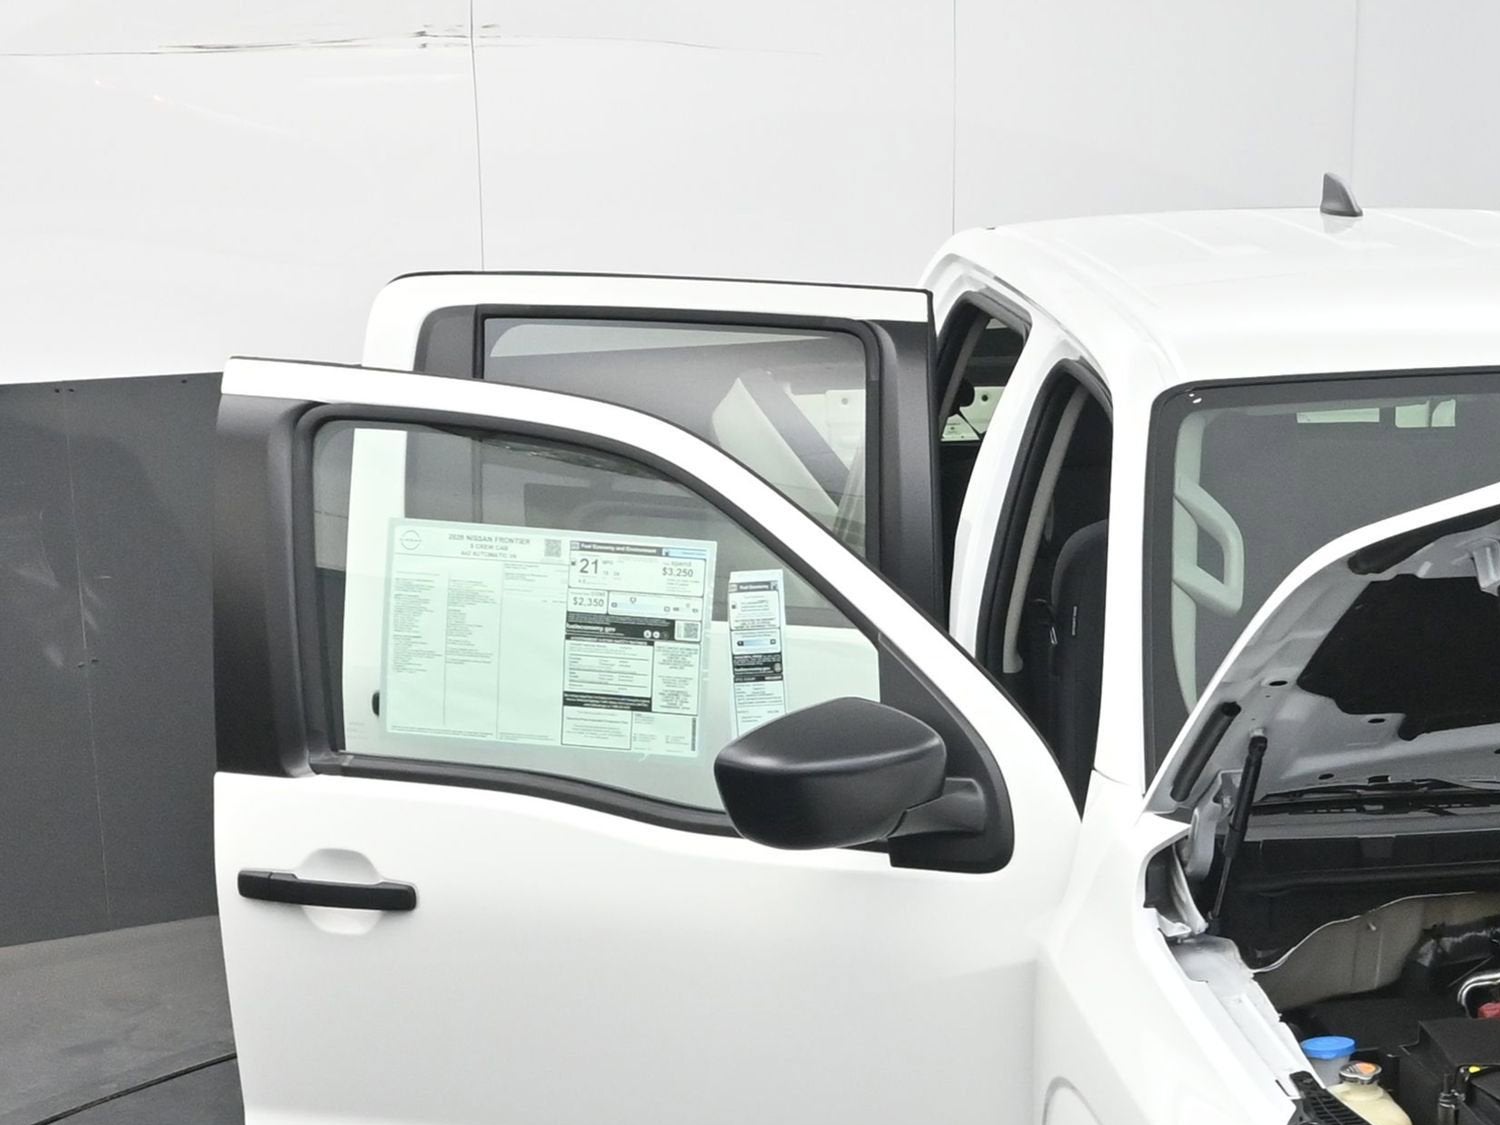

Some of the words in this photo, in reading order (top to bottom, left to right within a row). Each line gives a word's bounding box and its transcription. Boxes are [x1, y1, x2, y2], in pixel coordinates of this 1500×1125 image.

[466, 534, 493, 544] NISSAN
[495, 535, 530, 545] FRONTIER
[579, 558, 598, 574] 21
[662, 566, 694, 578] $3,250
[572, 596, 605, 608] $2,350
